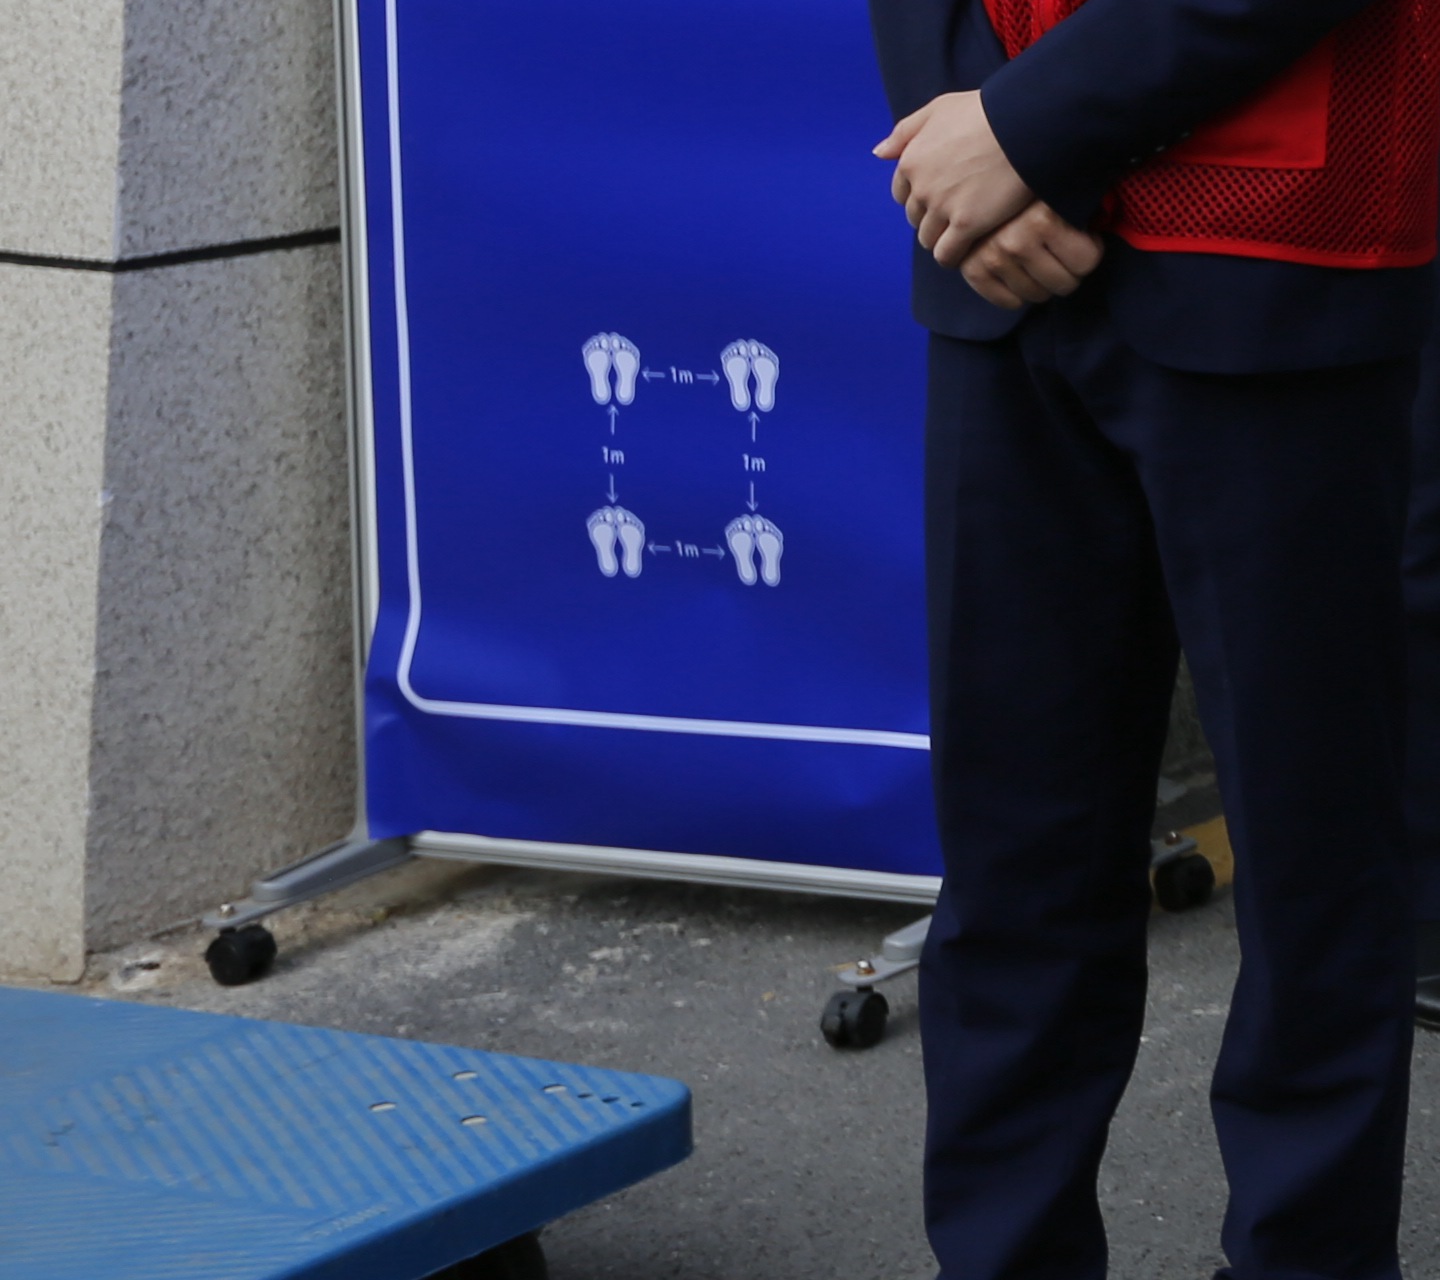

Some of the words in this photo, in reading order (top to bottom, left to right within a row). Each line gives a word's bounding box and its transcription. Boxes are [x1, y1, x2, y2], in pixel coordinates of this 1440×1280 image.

[670, 366, 693, 384] 1m
[602, 446, 625, 465] 1m
[743, 454, 766, 472] 1m
[675, 541, 699, 558] 1m
